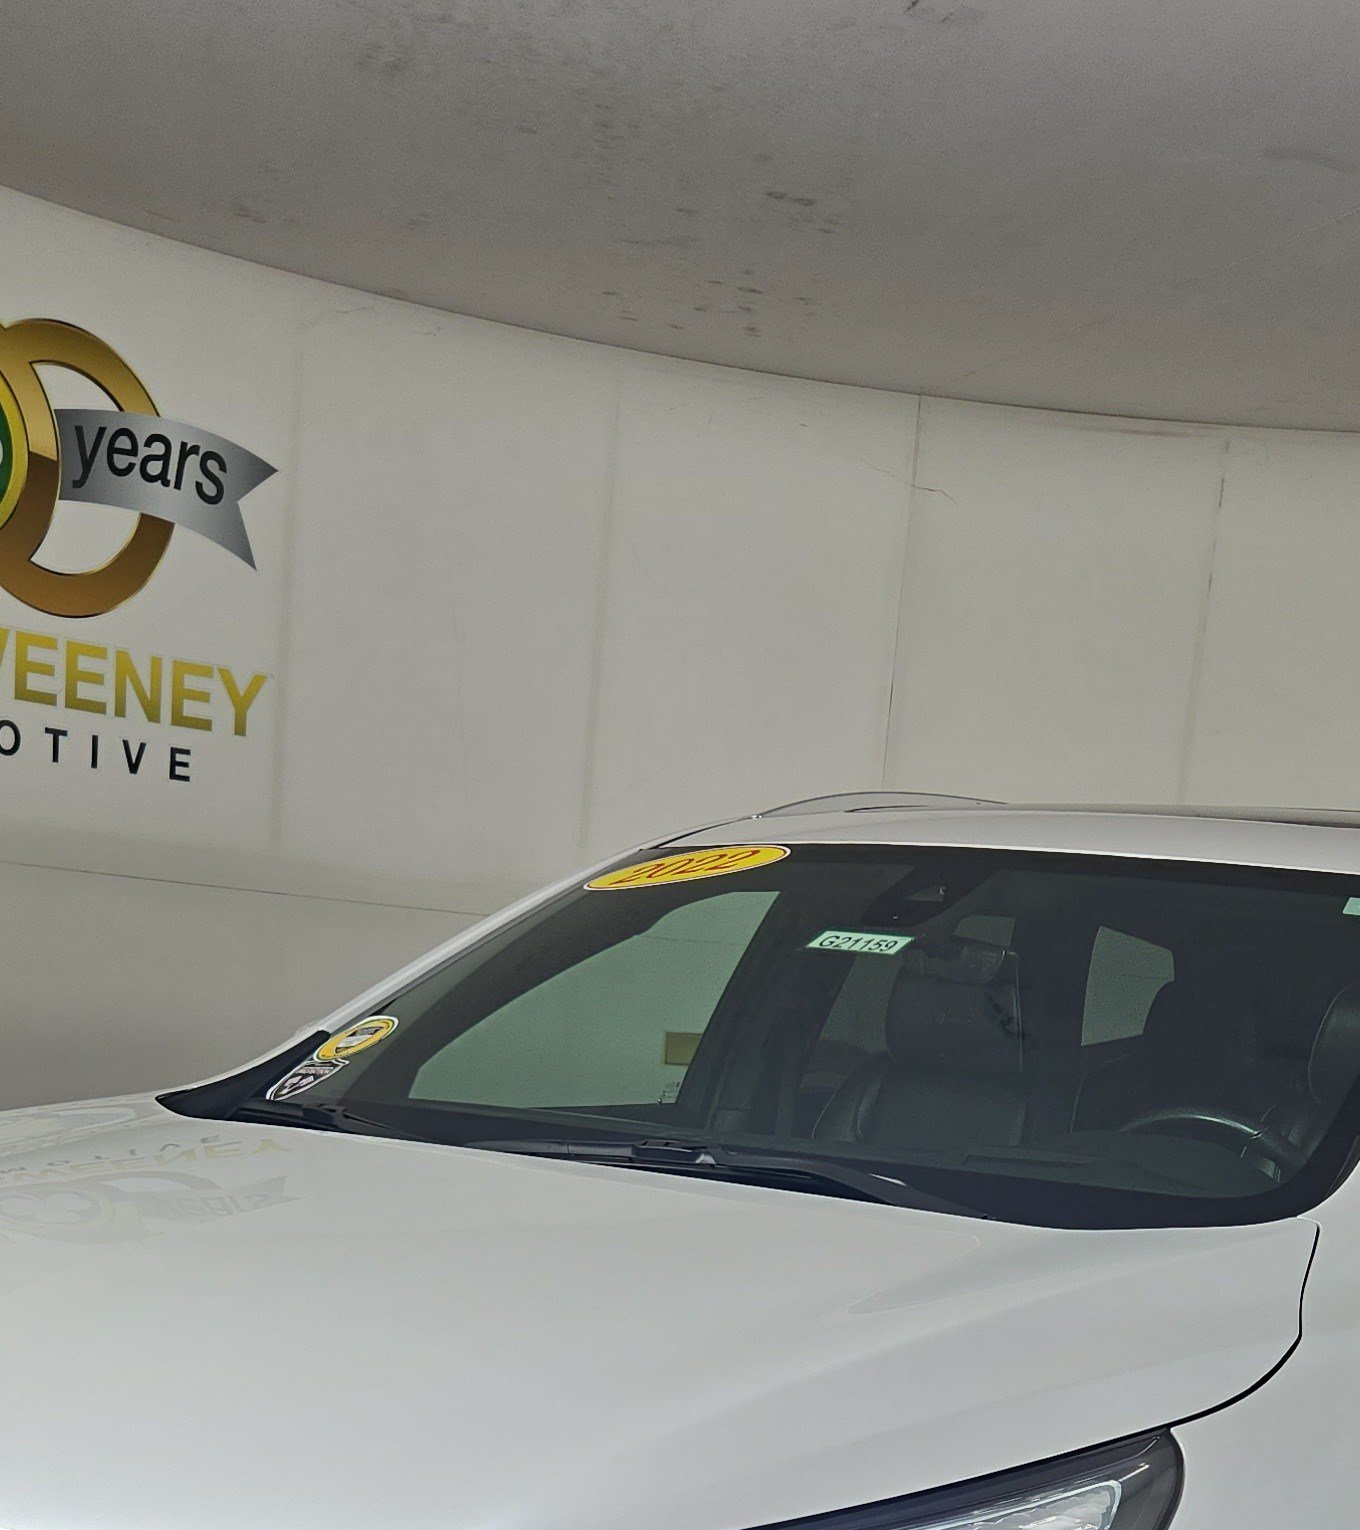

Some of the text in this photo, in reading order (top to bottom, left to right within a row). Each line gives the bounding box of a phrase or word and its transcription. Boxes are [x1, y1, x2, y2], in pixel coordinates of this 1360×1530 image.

[71, 423, 229, 506] years
[609, 850, 761, 886] 2022
[818, 934, 899, 953] G21159
